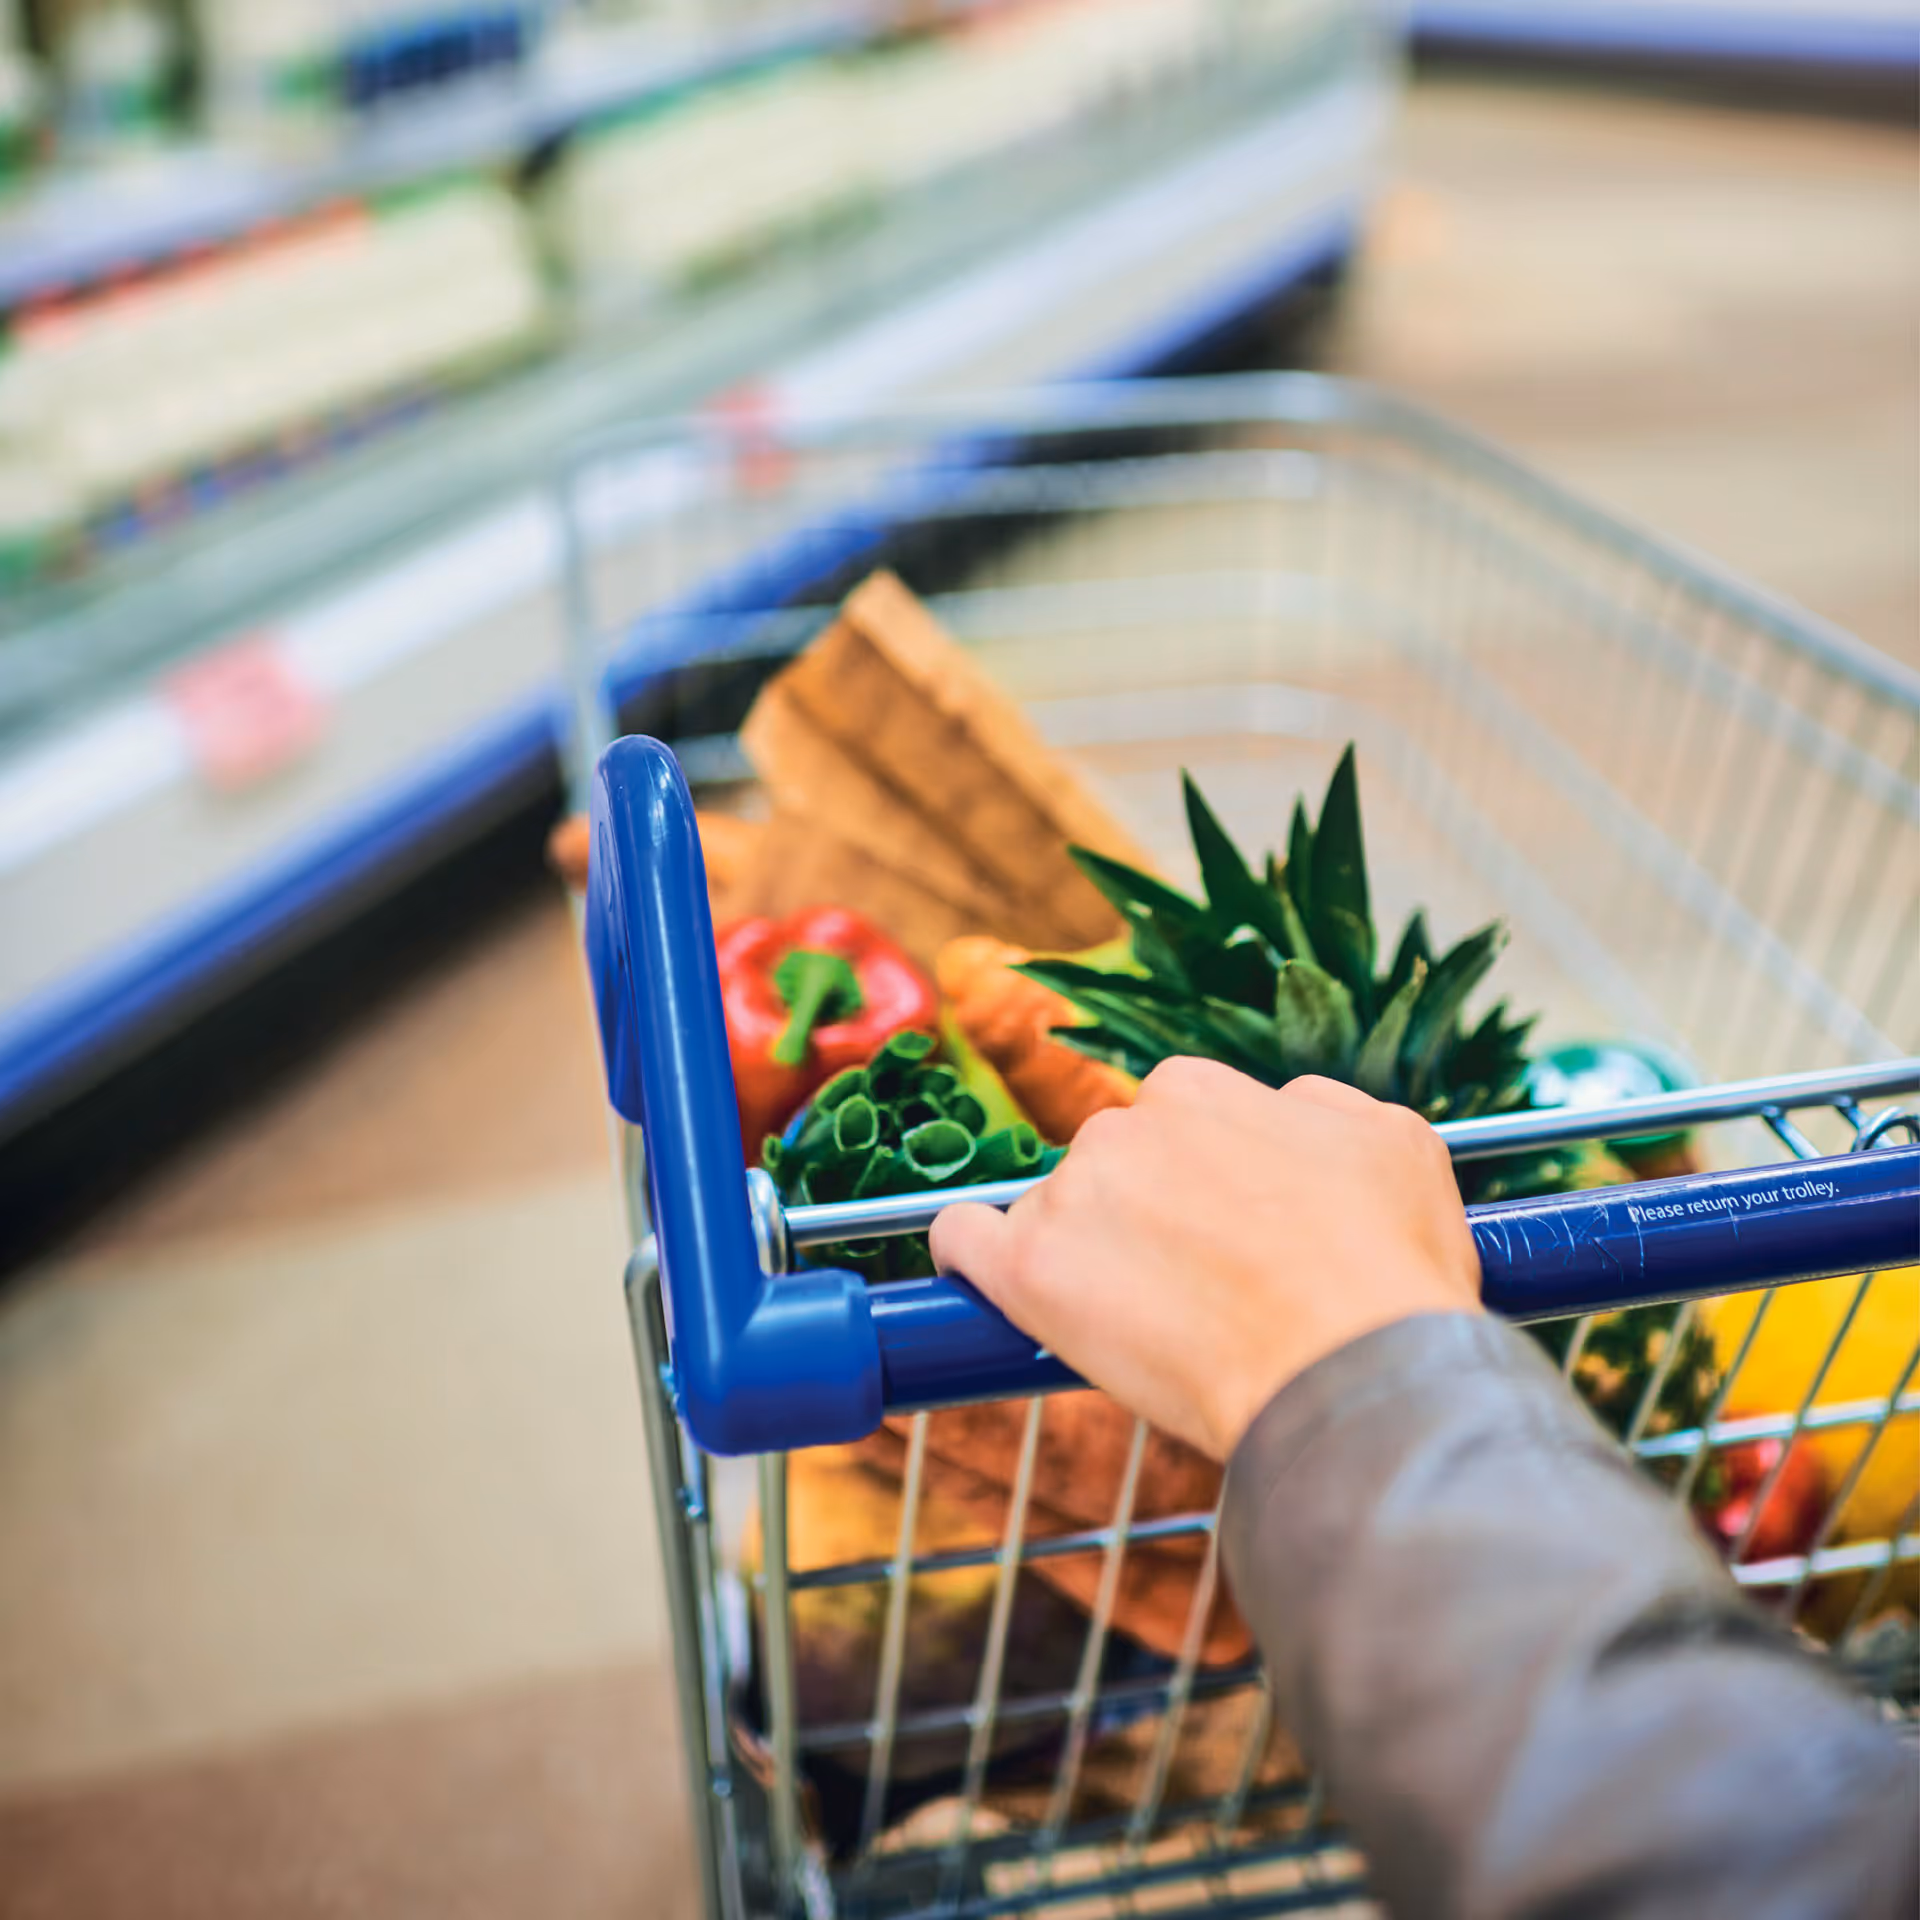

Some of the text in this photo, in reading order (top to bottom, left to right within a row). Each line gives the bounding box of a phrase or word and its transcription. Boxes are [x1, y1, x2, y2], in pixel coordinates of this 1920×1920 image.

[1628, 1180, 1840, 1223] Please return your trolley.
